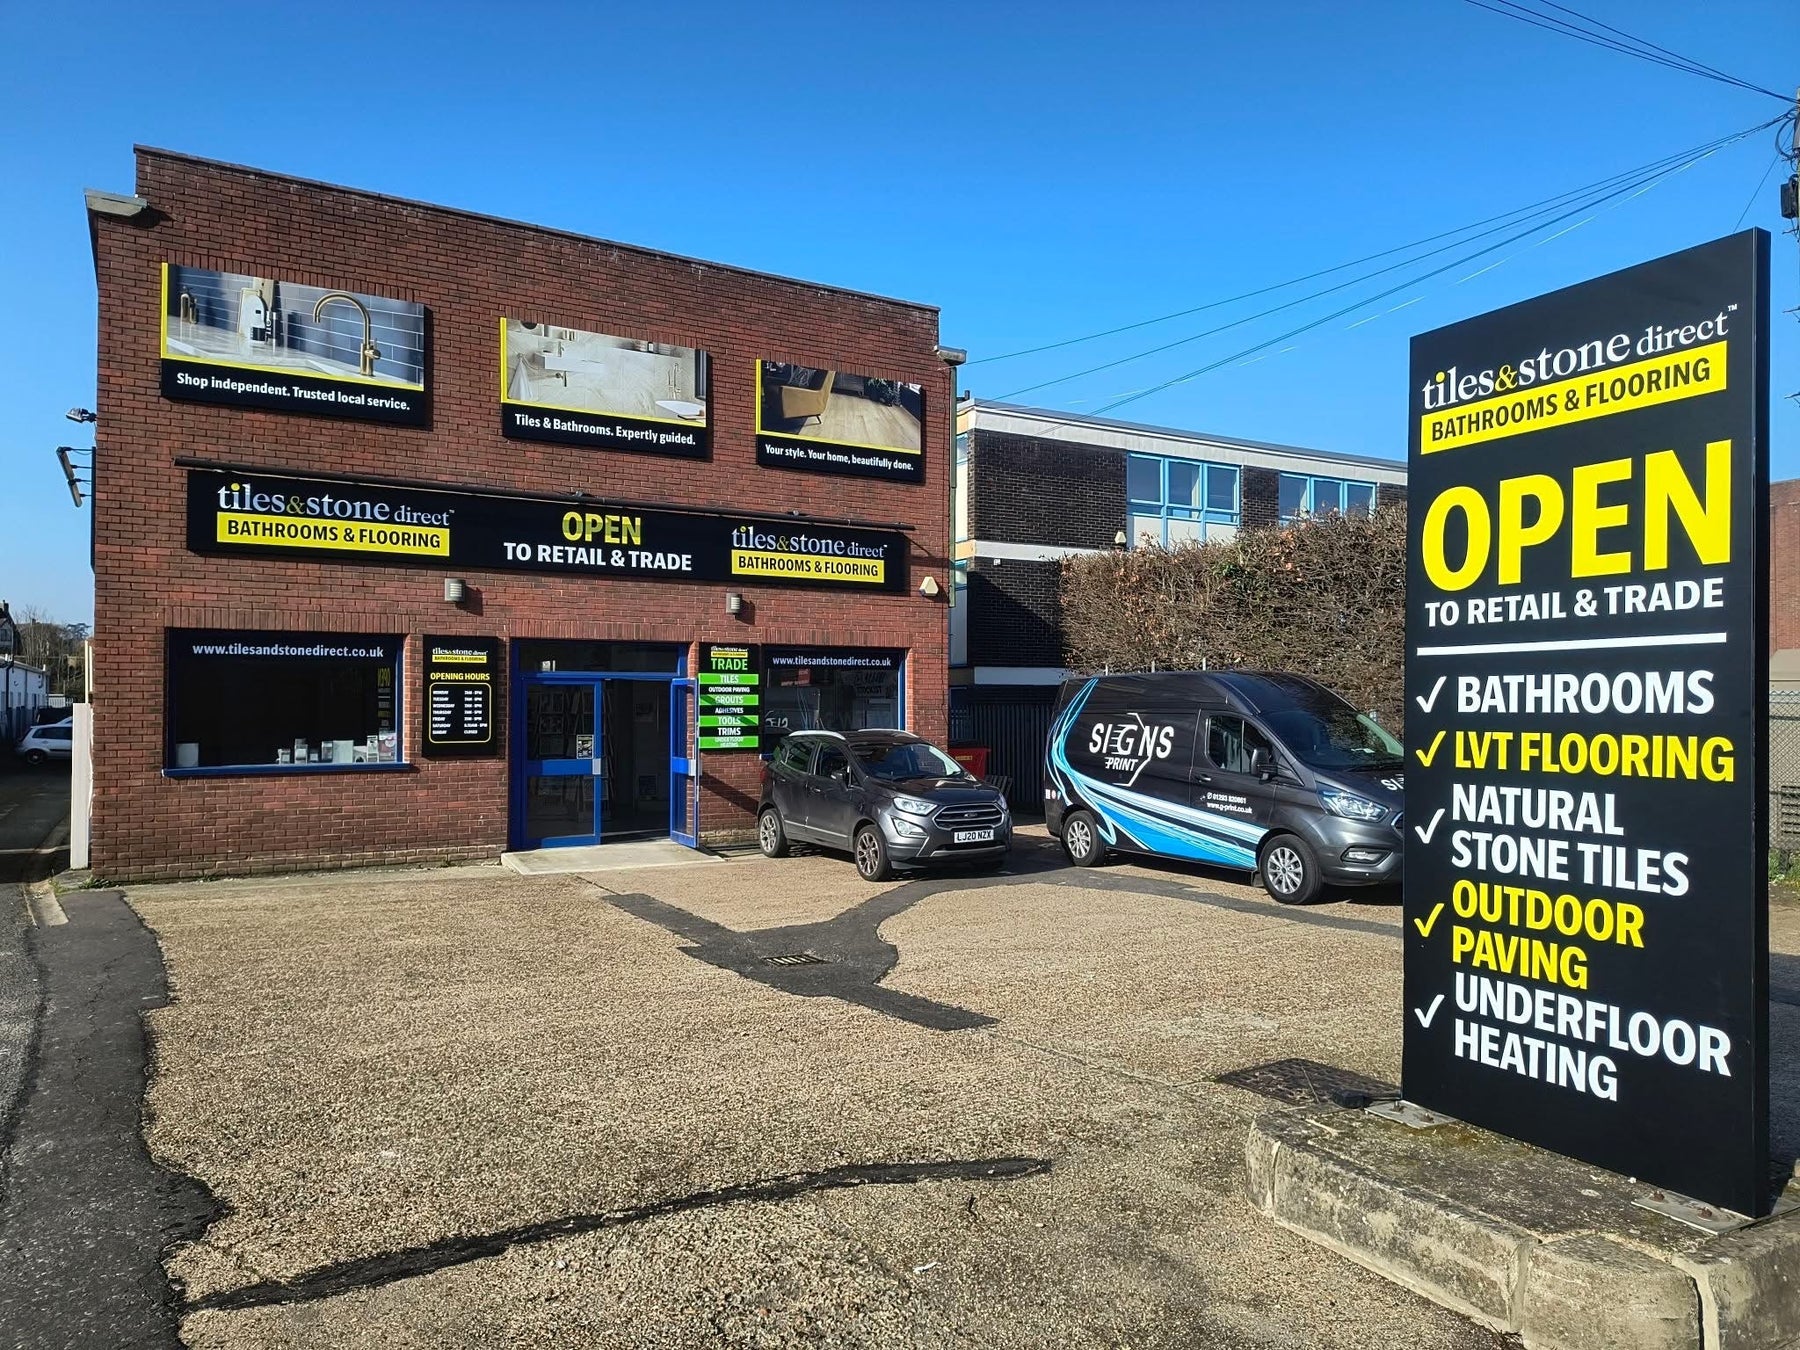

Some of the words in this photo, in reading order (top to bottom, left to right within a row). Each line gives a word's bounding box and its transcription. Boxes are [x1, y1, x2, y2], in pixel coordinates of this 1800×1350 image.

[1422, 332, 1632, 409] tiles&stone
[176, 372, 208, 389] Shop
[211, 376, 290, 396] independent.
[292, 386, 335, 402] Trusted
[337, 391, 365, 405] local
[367, 396, 411, 411] service.
[1431, 393, 1558, 442] BATHROOMS
[1564, 388, 1581, 411] &
[1585, 357, 1710, 408] FLOORING
[514, 413, 541, 428] Tiles
[542, 417, 552, 429] &
[553, 418, 614, 437] Bathrooms.
[616, 426, 658, 443] Expertly
[659, 433, 696, 445] guided.
[765, 444, 784, 455] Your
[785, 447, 807, 459] style.
[808, 449, 826, 460] Your
[827, 452, 850, 464] home,
[851, 454, 892, 470] beautifully
[893, 459, 914, 471] done.
[217, 482, 390, 520] tiles&stone
[1422, 439, 1732, 592] OPEN
[227, 519, 338, 542] BATHROOMS
[343, 526, 355, 543] &
[359, 528, 441, 548] FLOORING
[561, 511, 641, 545] OPEN
[731, 525, 845, 555] tiles&stone
[503, 542, 532, 561] TO
[537, 544, 606, 566] RETAIL
[610, 549, 625, 567] &
[628, 550, 692, 571] TRADE
[738, 555, 811, 572] BATHROOMS
[814, 560, 822, 573] &
[825, 561, 878, 576] FLOORING
[1425, 601, 1459, 627] TO
[1467, 590, 1566, 625] RETAIL
[1573, 589, 1597, 617] &
[1604, 577, 1724, 614] TRADE
[193, 643, 384, 658] www.tilesandstonedirect.co.uk
[711, 658, 748, 670] TRADE
[773, 655, 892, 666] www.tilesandstonedirect.co.uk
[430, 672, 464, 680] OPENING
[464, 672, 490, 681] HOURS
[720, 674, 740, 684] TILES
[1457, 670, 1714, 715] BATHROOMS
[715, 695, 743, 704] GROUTS
[717, 716, 741, 725] TOOLS
[717, 727, 741, 736] TRIMS
[1089, 722, 1175, 759] SIGNS
[1455, 731, 1513, 770] LVT
[1520, 732, 1734, 782] FLOORING
[1104, 756, 1139, 771] PRINT
[1452, 783, 1624, 836] NATURAL
[957, 832, 976, 841] LJ20
[978, 830, 992, 840] NZX
[1451, 829, 1568, 882] STONE
[1577, 842, 1690, 897] TILES
[1452, 879, 1645, 948] OUTDOOR
[1452, 925, 1588, 990] PAVING
[1454, 971, 1732, 1077] UNDERFLOOR
[1454, 1018, 1618, 1102] HEATING
